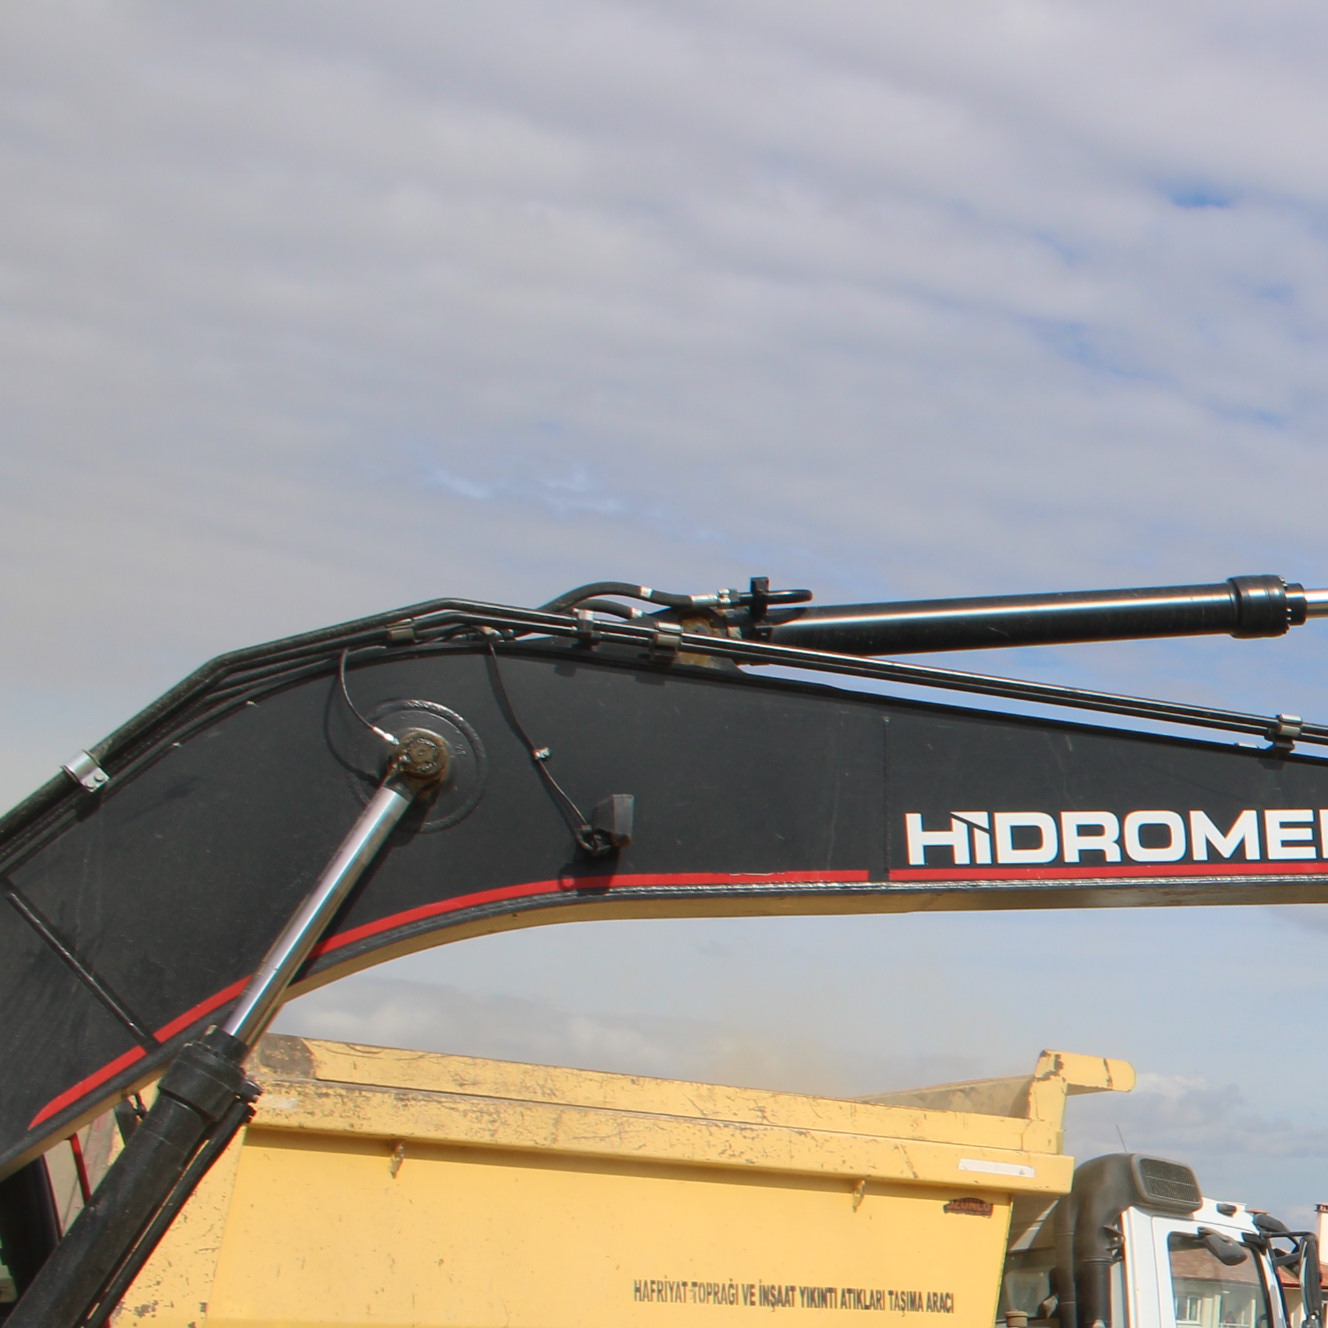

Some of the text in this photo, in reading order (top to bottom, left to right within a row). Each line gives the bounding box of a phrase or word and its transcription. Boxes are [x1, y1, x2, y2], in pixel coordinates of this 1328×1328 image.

[634, 1275, 954, 1317] HAFRİYAT TOPRAĞI VE İNŞAAT YIKINTI ATIKLARI TAŞIMA ARACI
